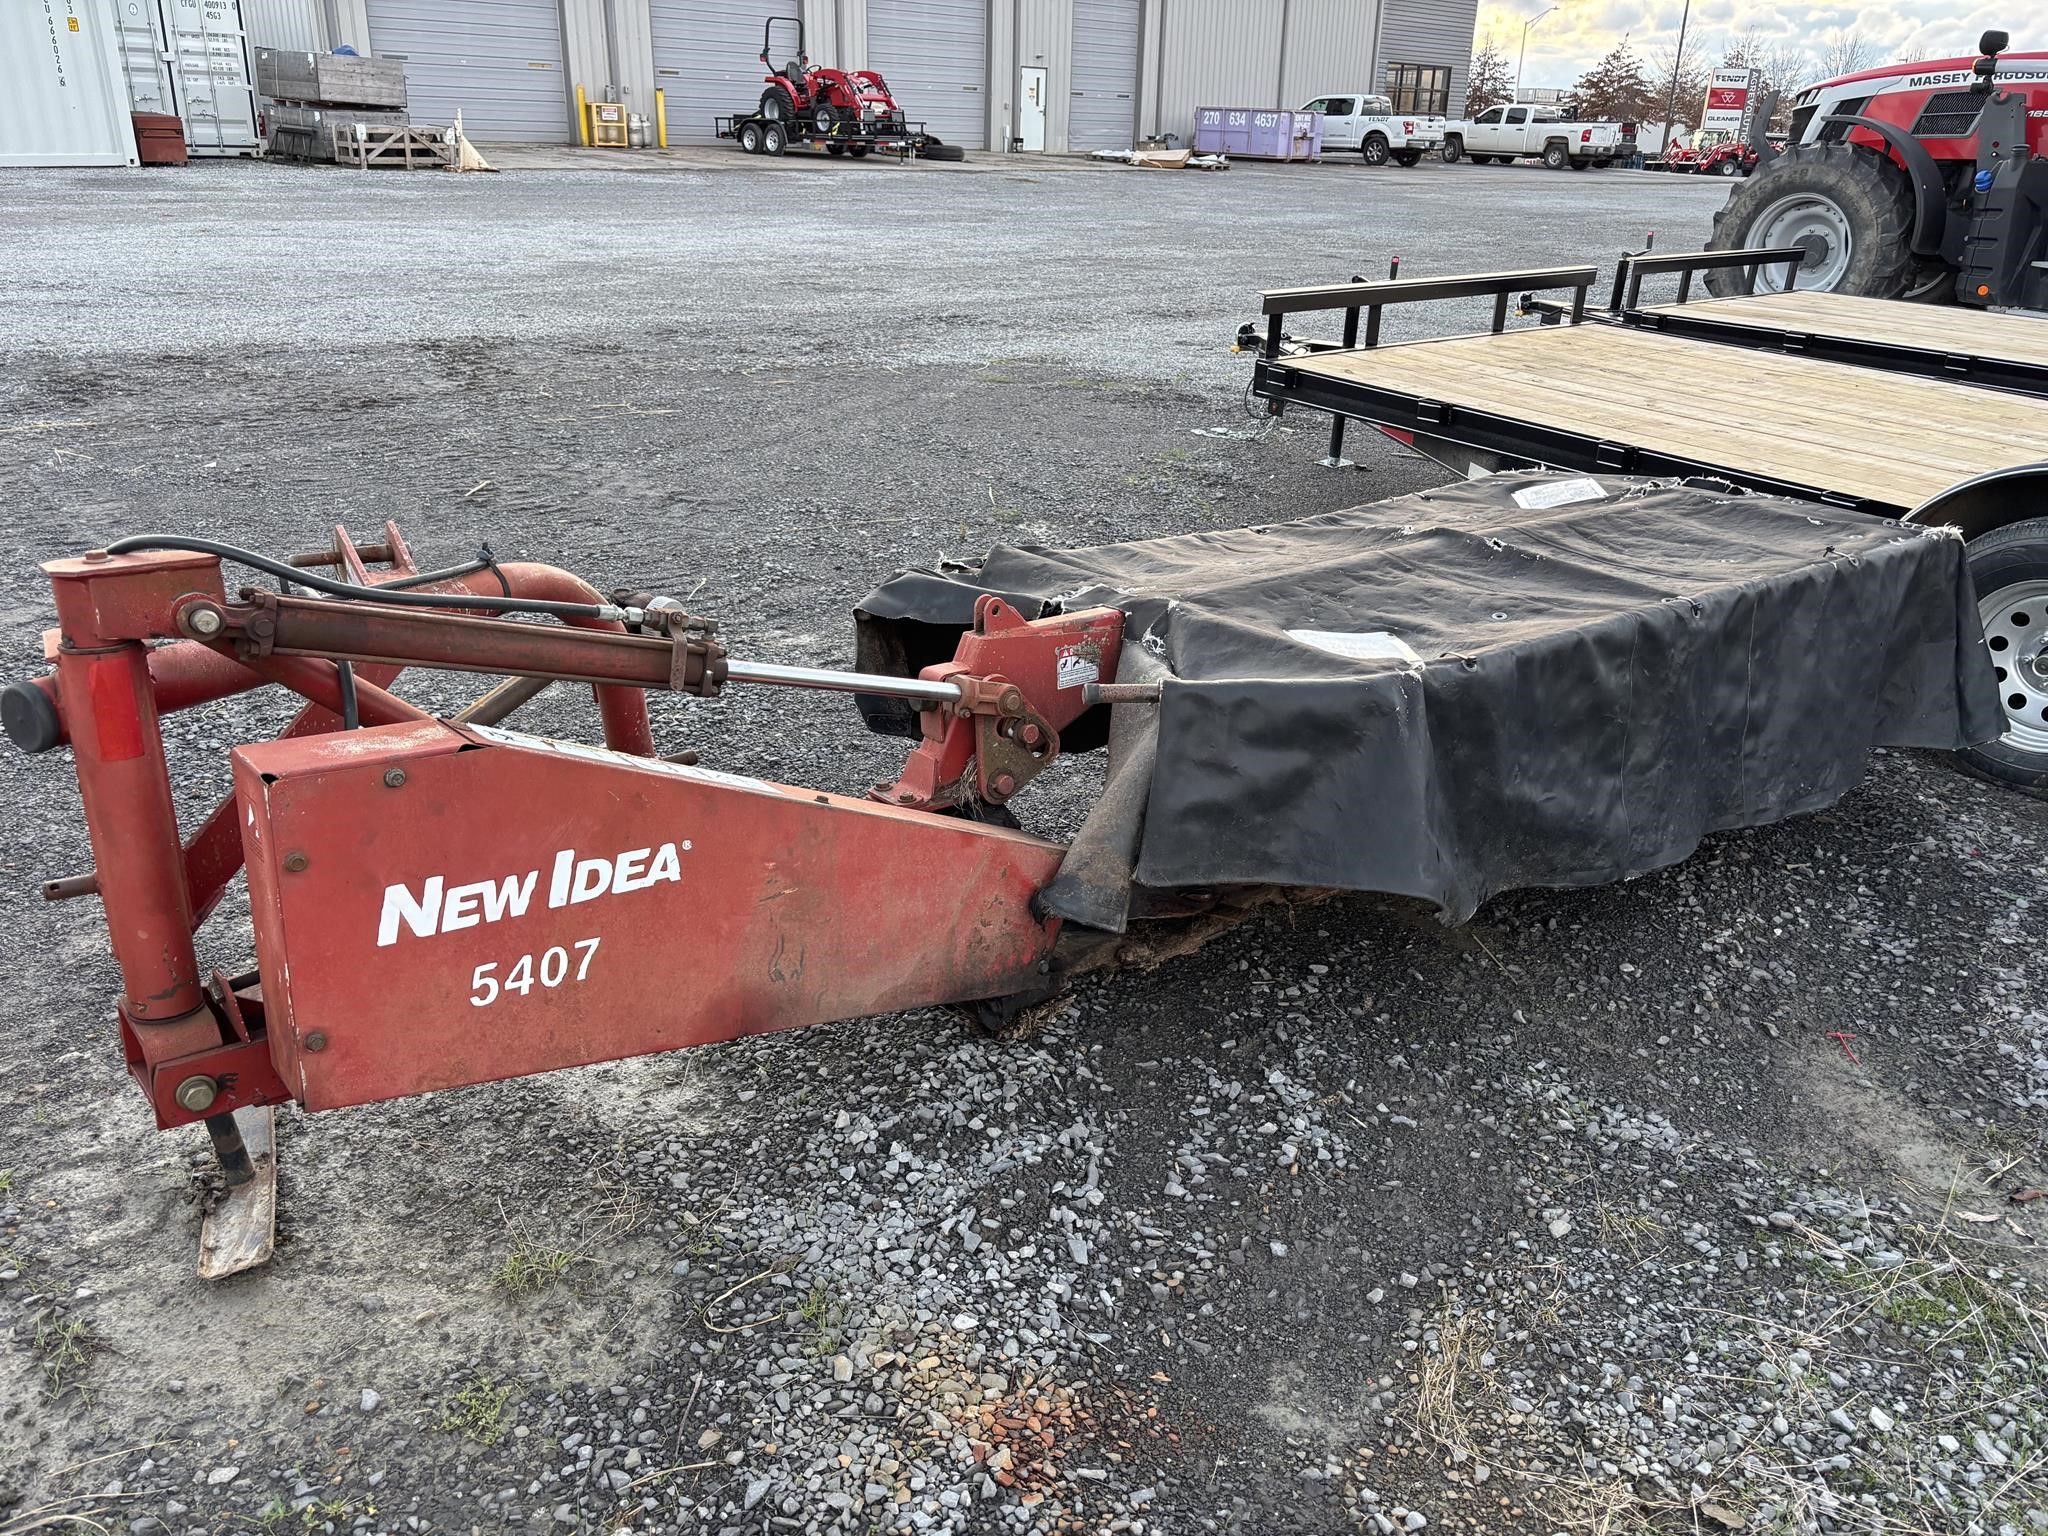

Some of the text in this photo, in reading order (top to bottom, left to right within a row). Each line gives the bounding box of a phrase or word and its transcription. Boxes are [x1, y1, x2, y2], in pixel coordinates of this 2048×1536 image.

[48, 16, 63, 74] 666026
[1715, 74, 1748, 83] FENDT
[1909, 71, 2048, 88] MASSEY FRGUSO
[1203, 111, 1220, 125] 270
[1229, 112, 1246, 126] 634
[1254, 112, 1278, 128] 4637
[376, 870, 540, 947] NEW
[469, 936, 601, 1008] 5407
